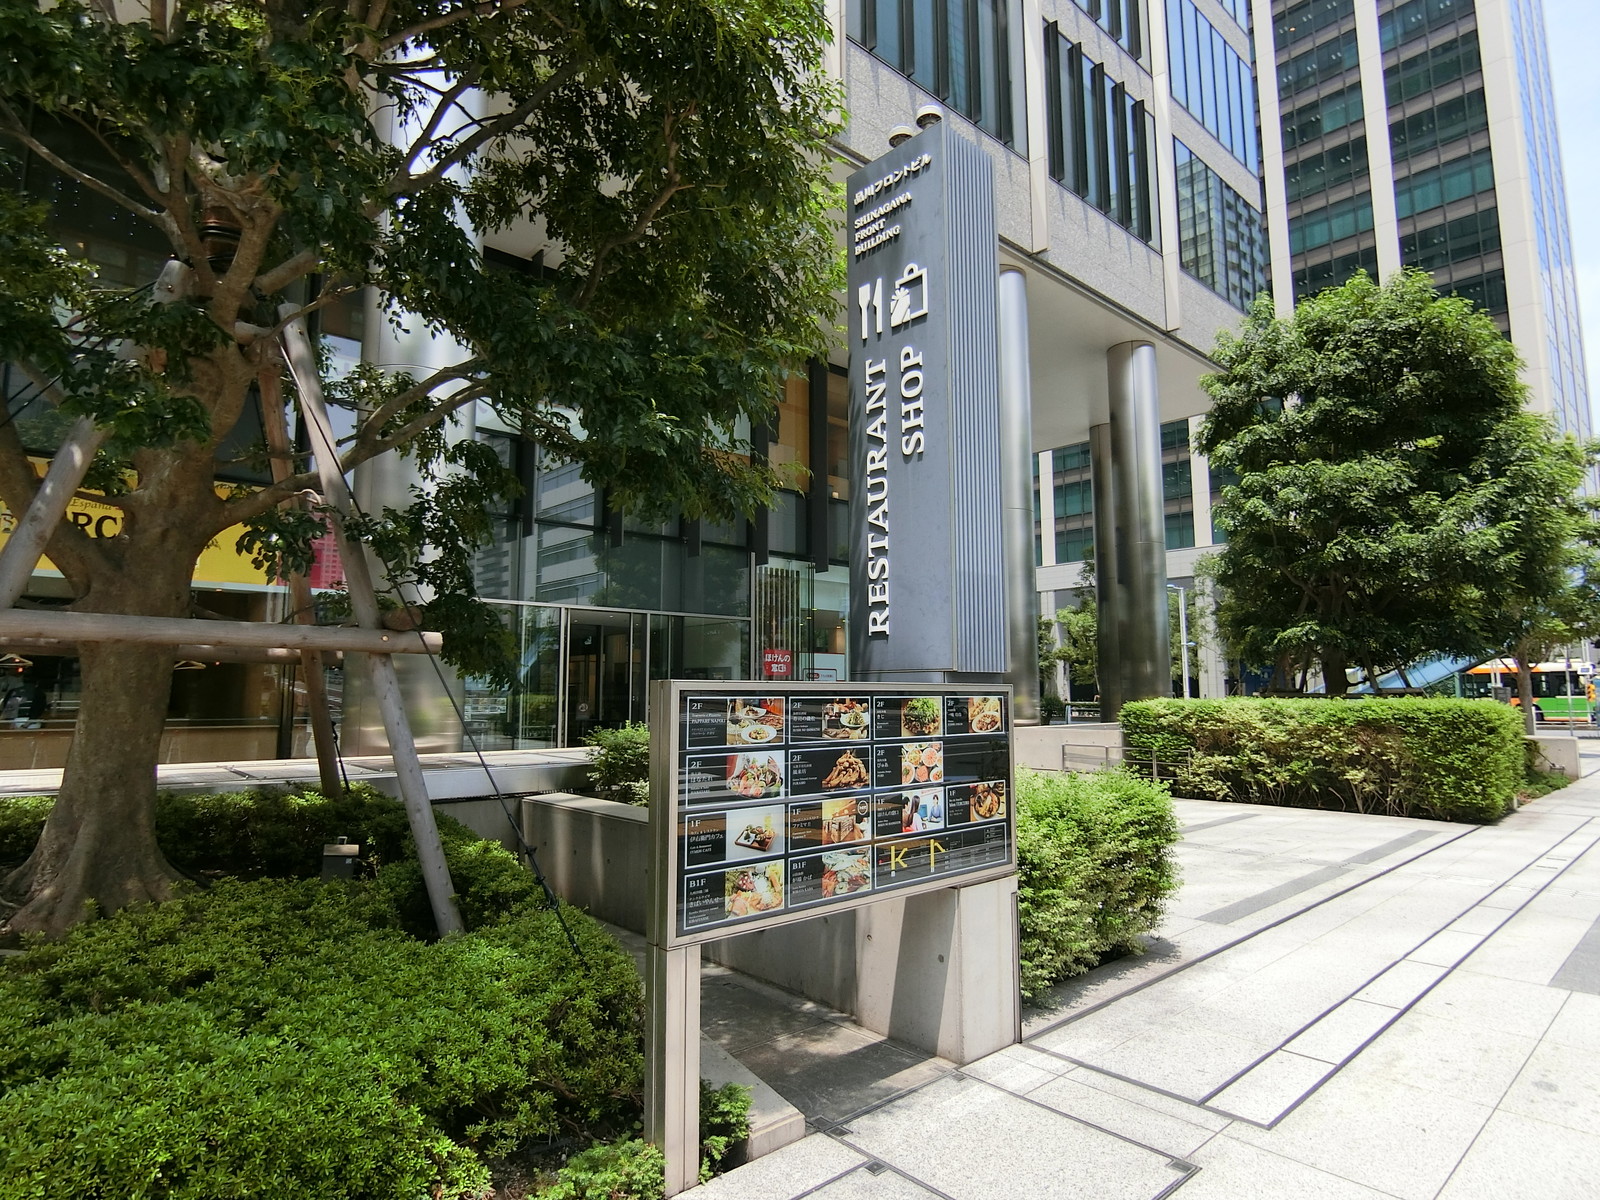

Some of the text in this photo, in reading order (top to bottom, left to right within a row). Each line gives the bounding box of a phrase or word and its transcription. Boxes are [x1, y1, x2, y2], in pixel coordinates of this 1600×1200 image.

[853, 153, 932, 206] 品川フロントビル
[854, 191, 913, 229] SHINAGAWA
[854, 218, 886, 243] FRONT
[854, 224, 901, 256] BUILDING
[900, 345, 925, 457] SHOP
[865, 358, 890, 637] RESTAURANT
[691, 702, 703, 710] 2F
[690, 761, 703, 769] 2F
[792, 808, 802, 816] 1F
[691, 820, 701, 828] 1F
[792, 861, 807, 870] B1F
[690, 878, 707, 888] B1F
